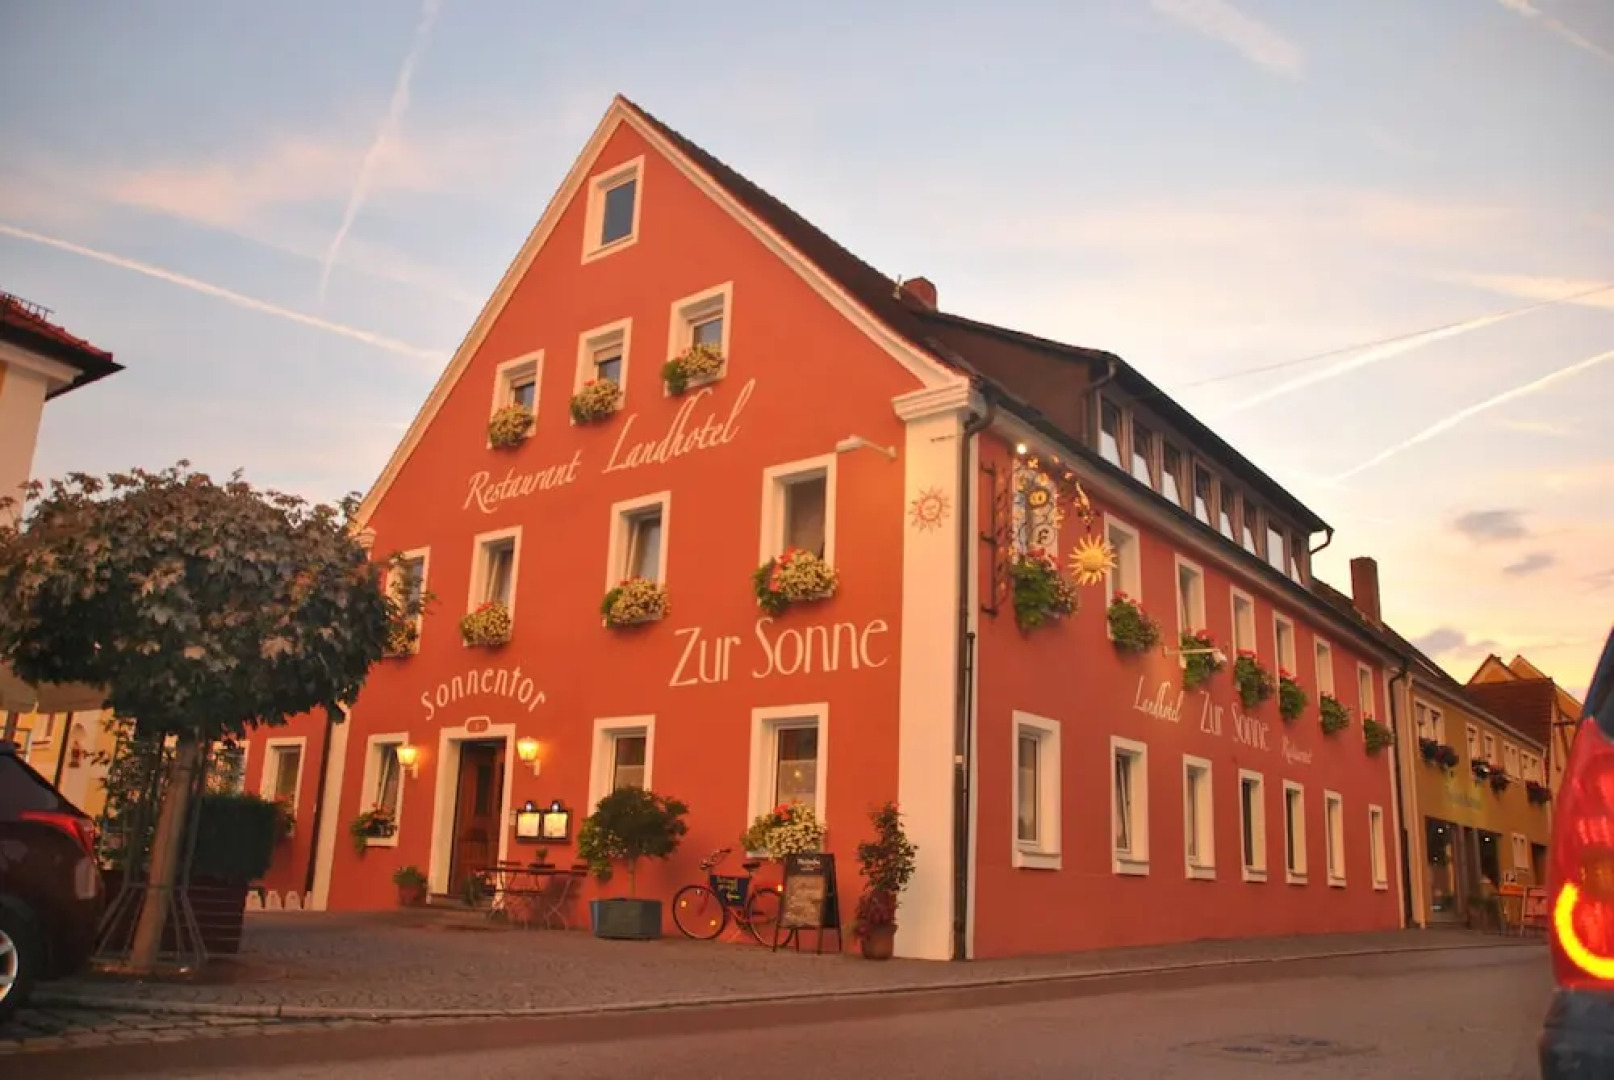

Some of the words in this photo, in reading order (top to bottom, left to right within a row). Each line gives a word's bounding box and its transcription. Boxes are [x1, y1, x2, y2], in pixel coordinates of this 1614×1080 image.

[463, 450, 582, 514] Restaurant
[602, 379, 756, 474] Landhotel
[669, 627, 741, 687] Zur
[752, 617, 889, 680] Sonne
[421, 666, 546, 721] Sonnentor
[1200, 690, 1224, 736] Zur
